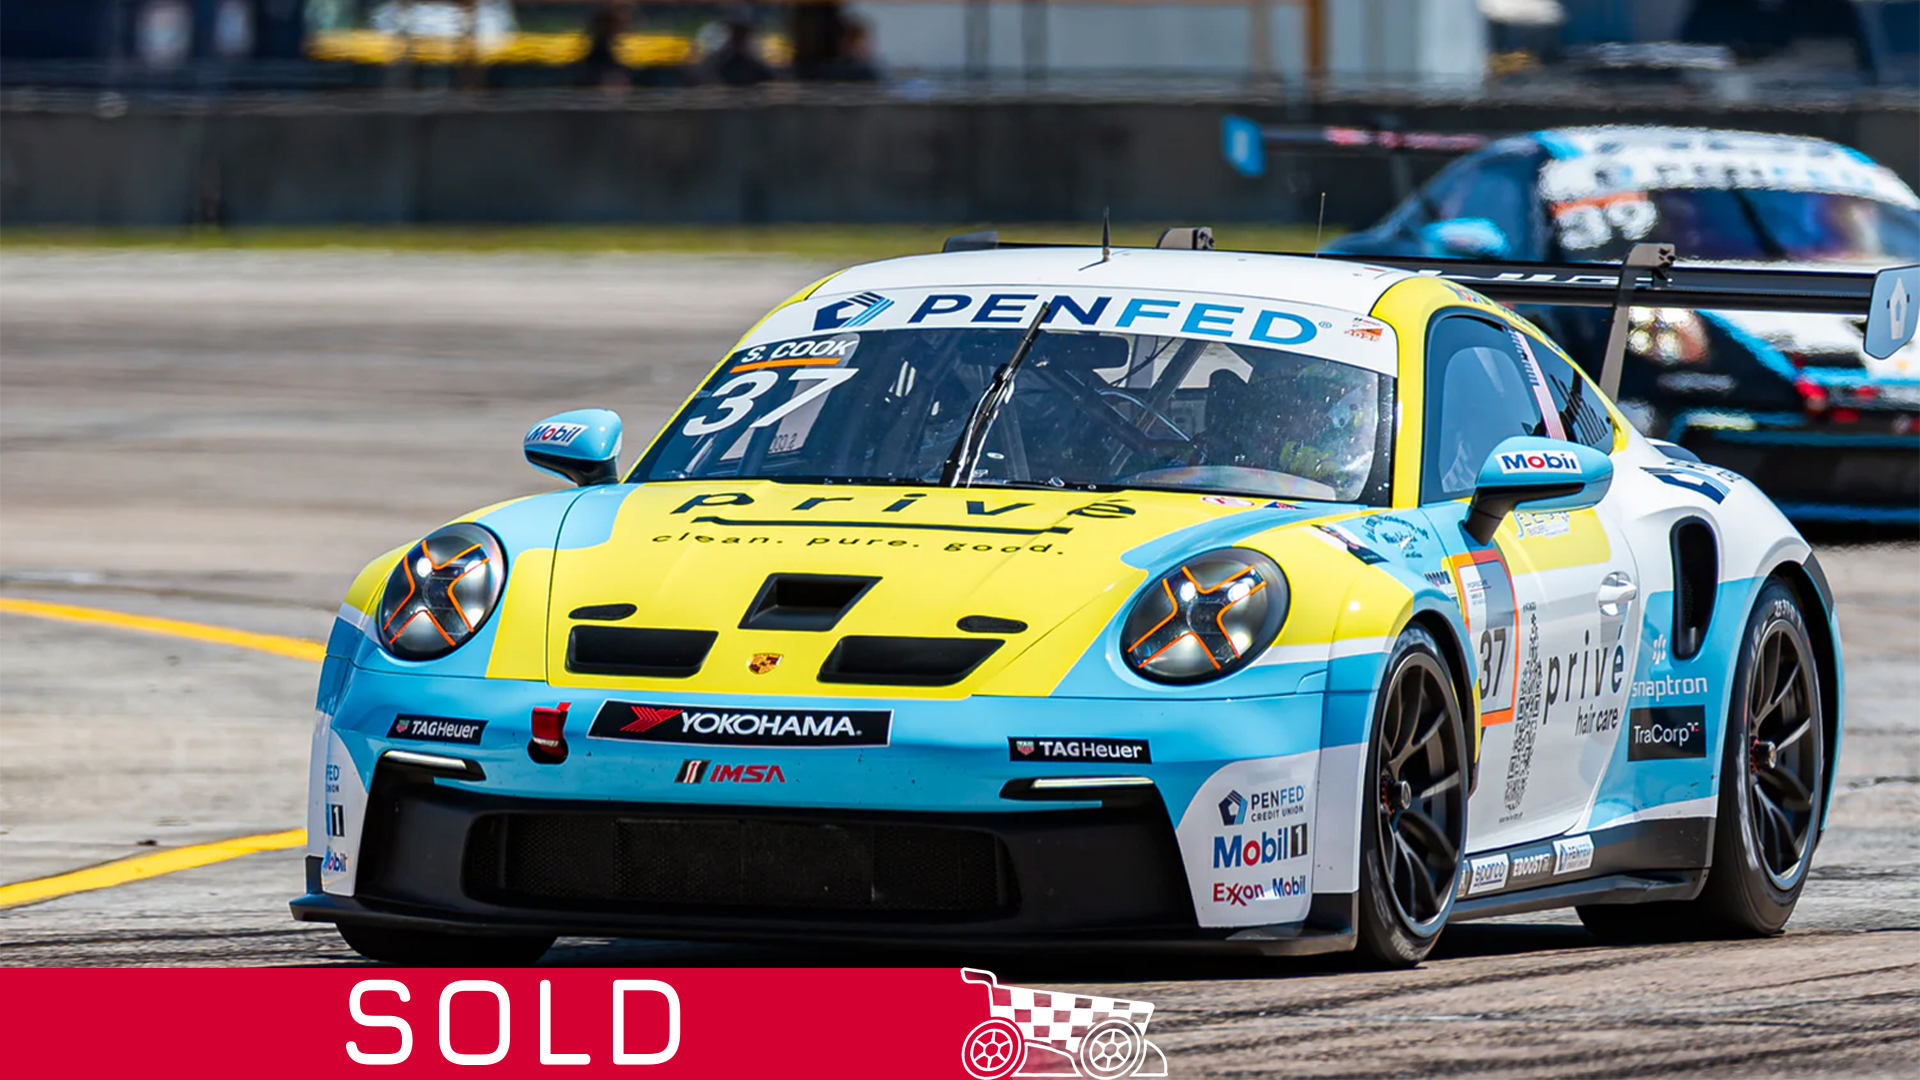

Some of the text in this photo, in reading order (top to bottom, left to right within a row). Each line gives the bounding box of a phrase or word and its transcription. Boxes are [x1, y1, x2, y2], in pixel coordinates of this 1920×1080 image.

[907, 293, 1318, 346] PENFED
[741, 340, 858, 363] S. COOK
[682, 367, 860, 437] 37
[527, 425, 582, 442] Mobil
[1501, 453, 1577, 469] Mobil
[670, 492, 1136, 518] privé
[652, 532, 1064, 555] clean. pure. good.
[1478, 627, 1507, 701] 37
[1543, 624, 1625, 726] privé
[1632, 674, 1708, 702] snaptron
[680, 711, 857, 737] YOKOHAMA
[1575, 704, 1619, 736] hair care
[1633, 723, 1690, 747] TraCorp
[708, 764, 786, 784] IMSA
[1250, 784, 1305, 811] PENFED
[1250, 804, 1305, 822] CREDIT UNION
[1213, 875, 1306, 907] Exxon Mobil
